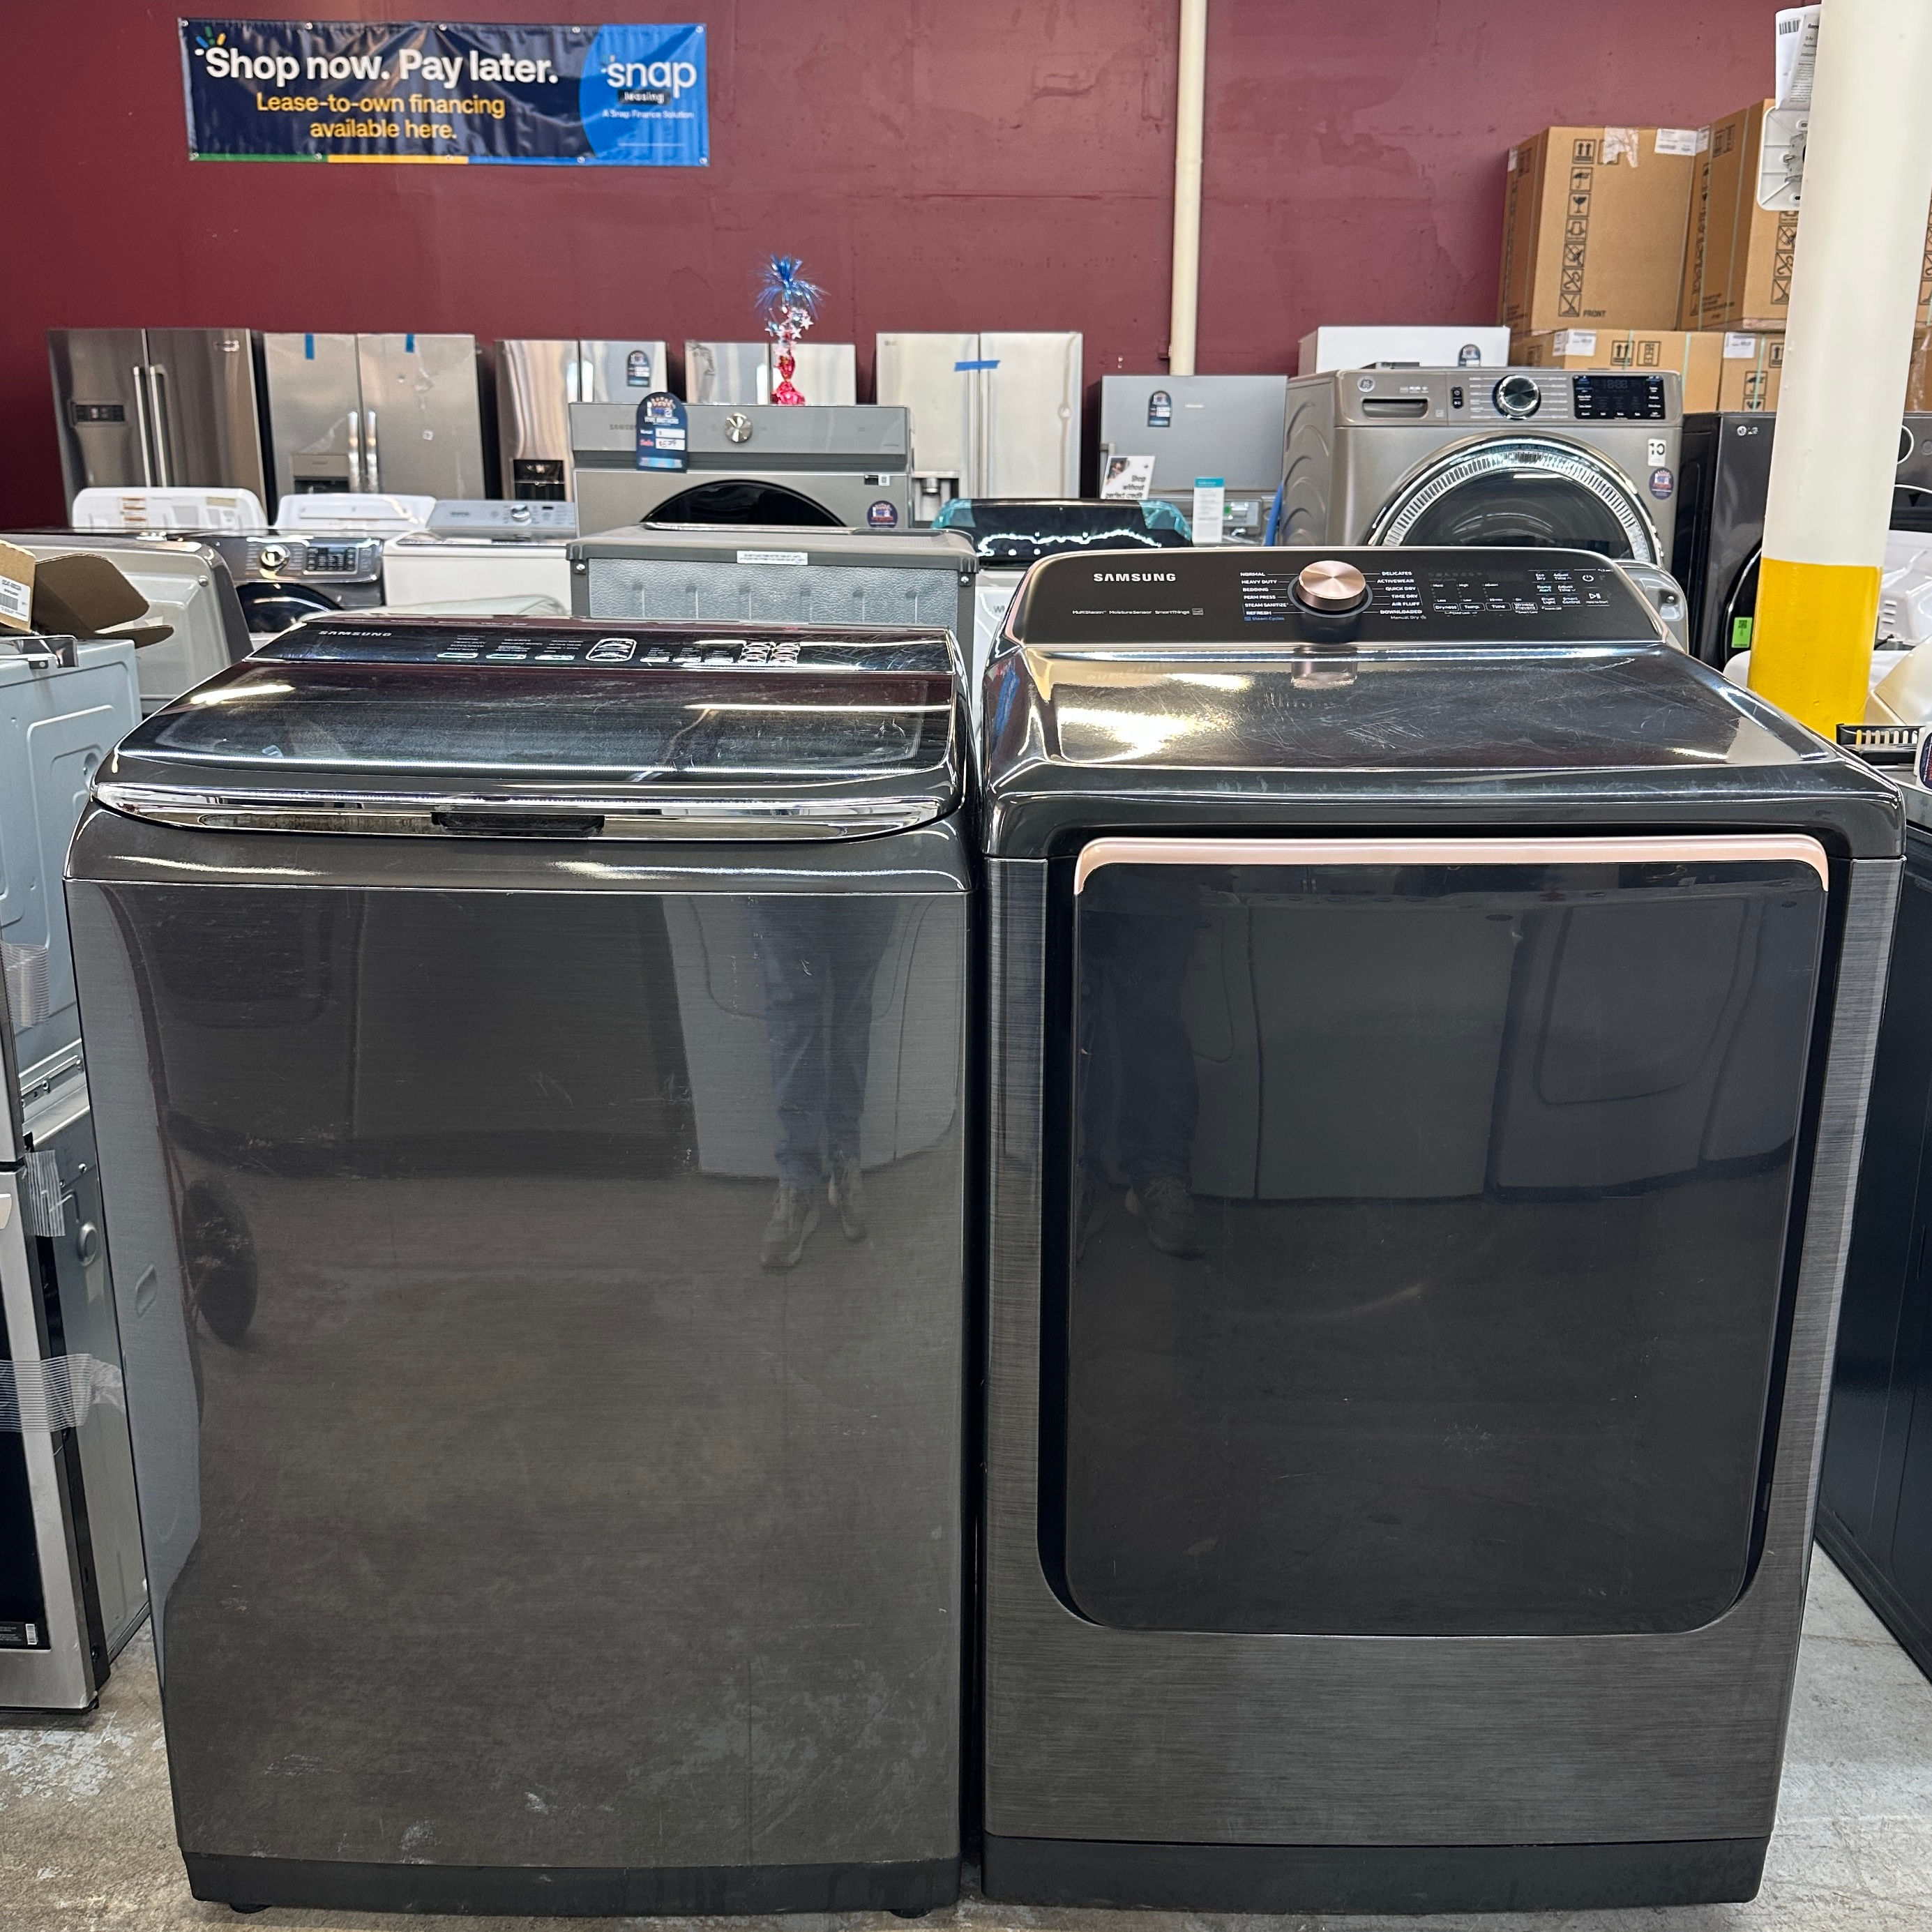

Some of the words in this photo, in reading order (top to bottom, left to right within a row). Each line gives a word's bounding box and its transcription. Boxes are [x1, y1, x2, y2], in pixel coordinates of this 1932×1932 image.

[205, 47, 301, 88] Shop
[306, 55, 391, 81] now.
[399, 48, 464, 89] Pay
[469, 50, 559, 84] later.
[607, 61, 697, 99] snap
[256, 91, 405, 113] Lease-to-own
[409, 93, 506, 119] financing
[309, 119, 400, 138] available
[405, 119, 458, 139] here.
[1093, 573, 1177, 582] SAMSUNG
